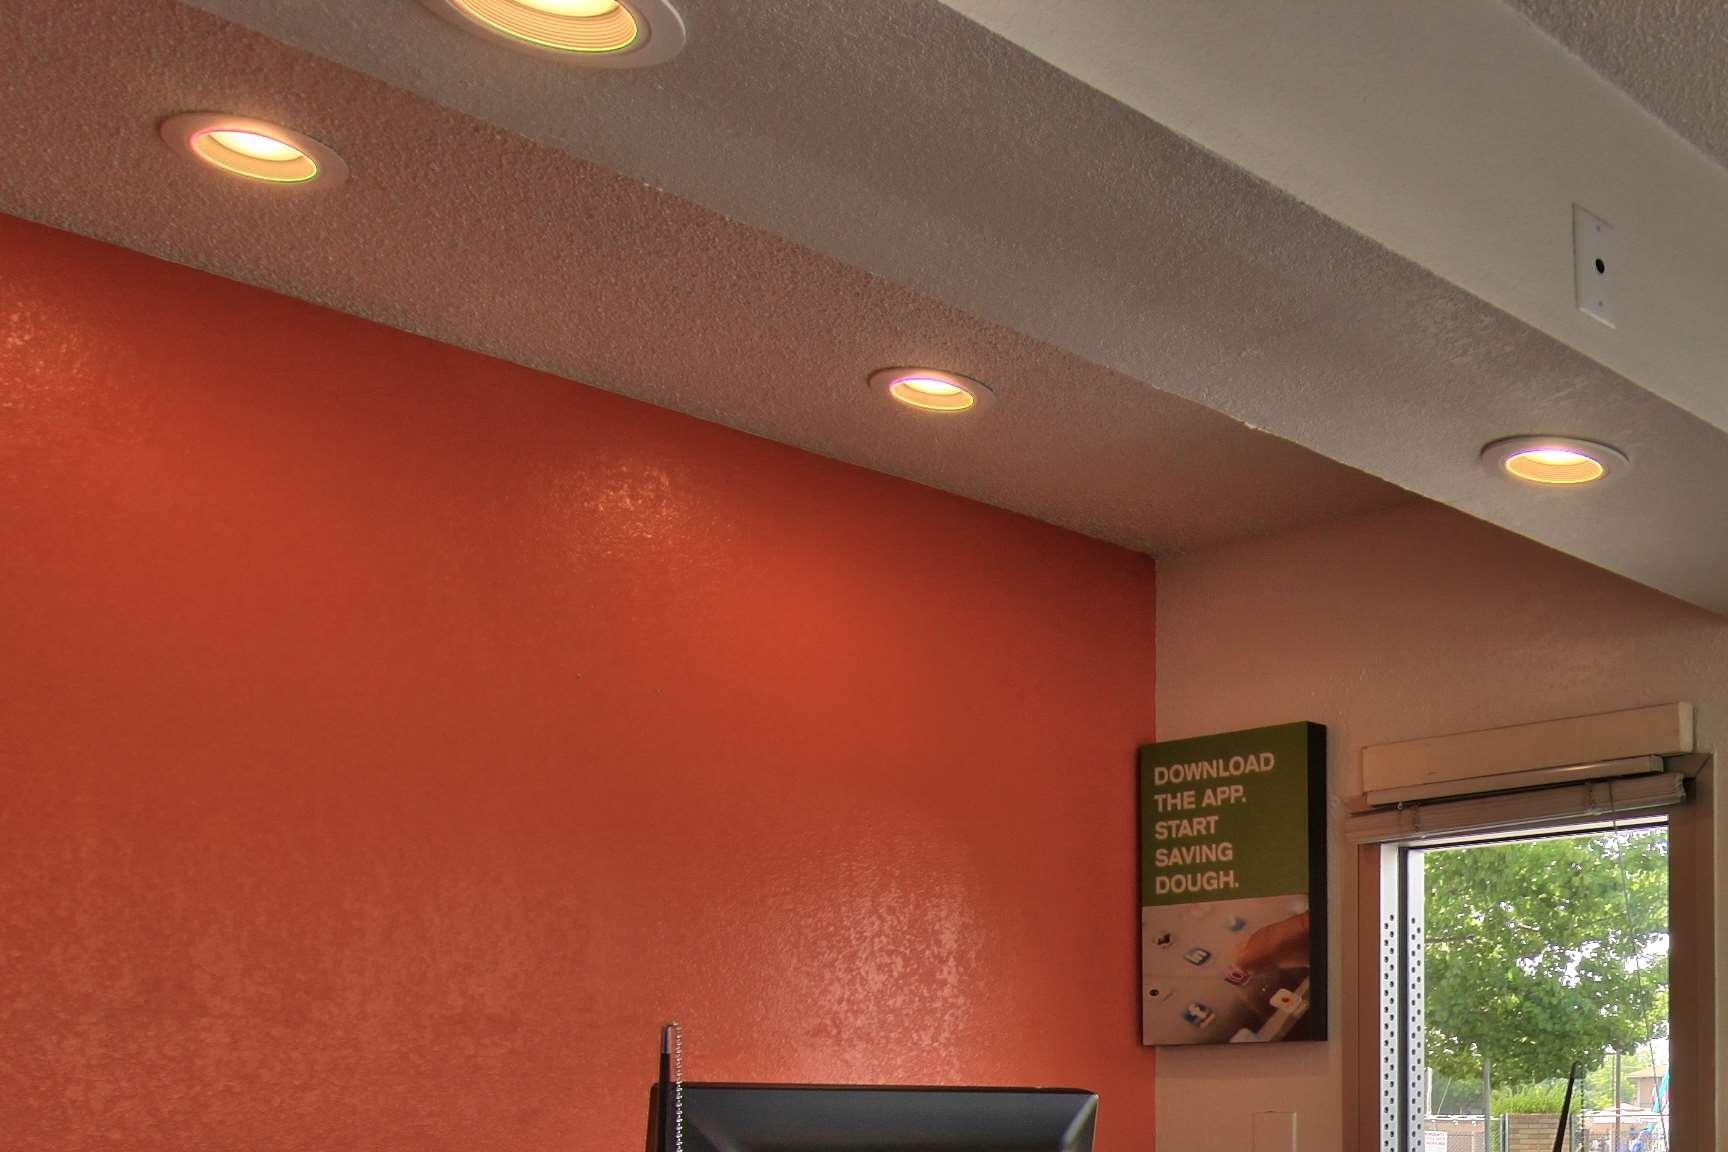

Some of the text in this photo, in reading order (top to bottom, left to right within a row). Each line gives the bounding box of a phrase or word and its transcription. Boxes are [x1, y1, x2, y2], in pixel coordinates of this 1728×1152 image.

[1154, 752, 1275, 786] DOWNLOAD
[1154, 784, 1247, 813] THE APP.
[1155, 816, 1219, 840] START
[1155, 842, 1234, 868] SAVING
[1155, 869, 1239, 895] DOUGH.
